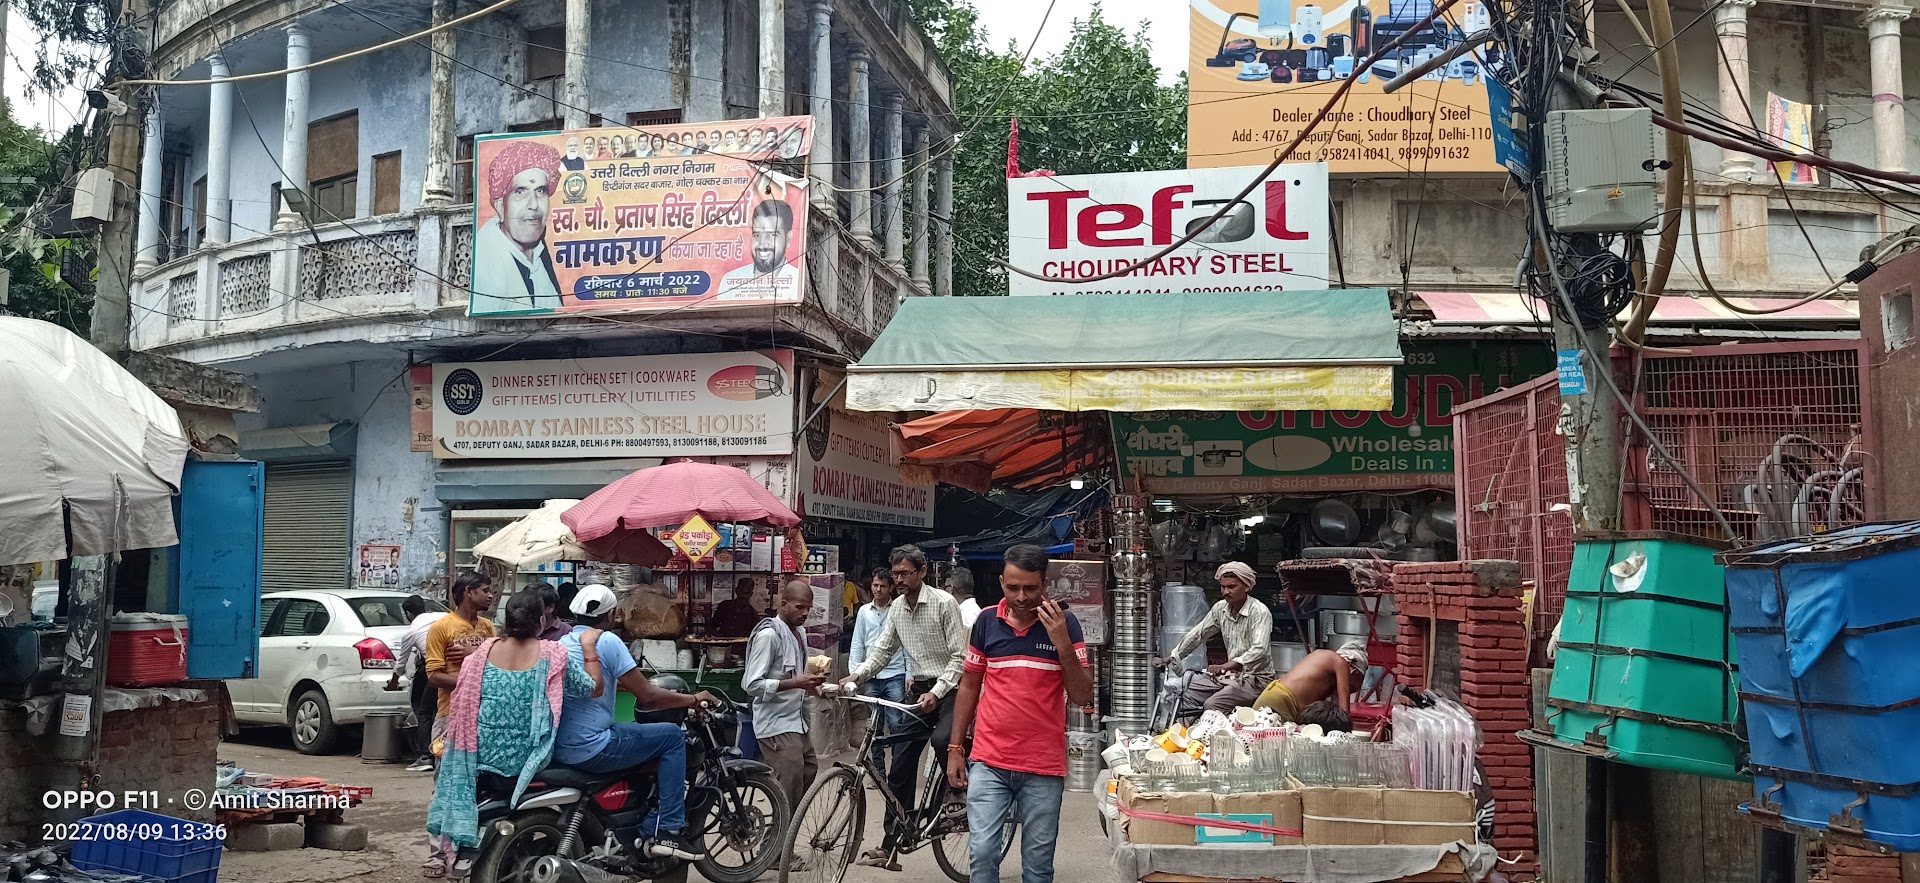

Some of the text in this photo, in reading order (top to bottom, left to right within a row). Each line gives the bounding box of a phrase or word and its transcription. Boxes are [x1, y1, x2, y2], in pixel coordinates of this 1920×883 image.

[1273, 107, 1313, 122] Dealer
[1367, 106, 1434, 124] Choudhary
[1440, 105, 1470, 120] Steel
[1232, 129, 1252, 141] Add
[1337, 130, 1364, 144] Ganj,
[1368, 128, 1398, 141] Sadar
[1402, 129, 1434, 142] Bazar,
[1274, 147, 1470, 161] Cntact 9582414041, 9899091632
[590, 164, 616, 178] उत्तरी
[620, 162, 650, 177] दिल्ली
[653, 165, 681, 176] नगर
[682, 160, 715, 175] निगम
[633, 181, 649, 190] सदर
[676, 177, 694, 187] गोल
[695, 178, 720, 186] चक्कर
[722, 177, 732, 185] का
[552, 208, 579, 233] स्व.
[584, 196, 608, 231] चौ.
[614, 204, 659, 234] प्रताप
[662, 192, 696, 229] सिंह
[1026, 180, 1309, 250] Tefal
[553, 232, 744, 268] नामकरण किया जा रहा है
[1043, 253, 1293, 280] CHOUDHARY STEEL
[584, 272, 700, 290] रविवार 6 मार्च 2022
[593, 290, 617, 298] समय
[647, 288, 669, 296] 11:30
[672, 285, 688, 294] बजे
[492, 370, 697, 387] DINNER SET KITCHEN SET COOKWARE
[1104, 370, 1237, 386] CHOUDHARY
[1242, 369, 1310, 384] STEEL
[450, 383, 476, 399] SST
[492, 390, 696, 406] GIFT ITEMS CUTLERY UTILITIES
[1151, 389, 1200, 398] Showroom
[1274, 387, 1301, 397] Hotel
[1332, 386, 1344, 397] All
[1347, 386, 1366, 396] Gift
[455, 413, 767, 438] BOMBAY STAINLESS STEEL HOUSE
[453, 437, 767, 451] 4707, DEPUTY GANJ, SADAR BAZAR, DELHI-6 PH: 8800497593, 8130091188, 8130091186
[830, 432, 844, 451] GIFT
[1352, 456, 1409, 472] Deals
[1416, 455, 1435, 470] In
[813, 465, 851, 500] BOMBAY
[852, 474, 887, 507] STAINLESS
[887, 481, 904, 509] STEEL
[906, 486, 927, 512] HOUSE
[1173, 479, 1224, 491] Deputy
[1229, 478, 1267, 491] Ganj,
[1271, 476, 1315, 488] Sadar
[1318, 475, 1363, 489] Bazar,
[1373, 474, 1411, 487] Delhi-
